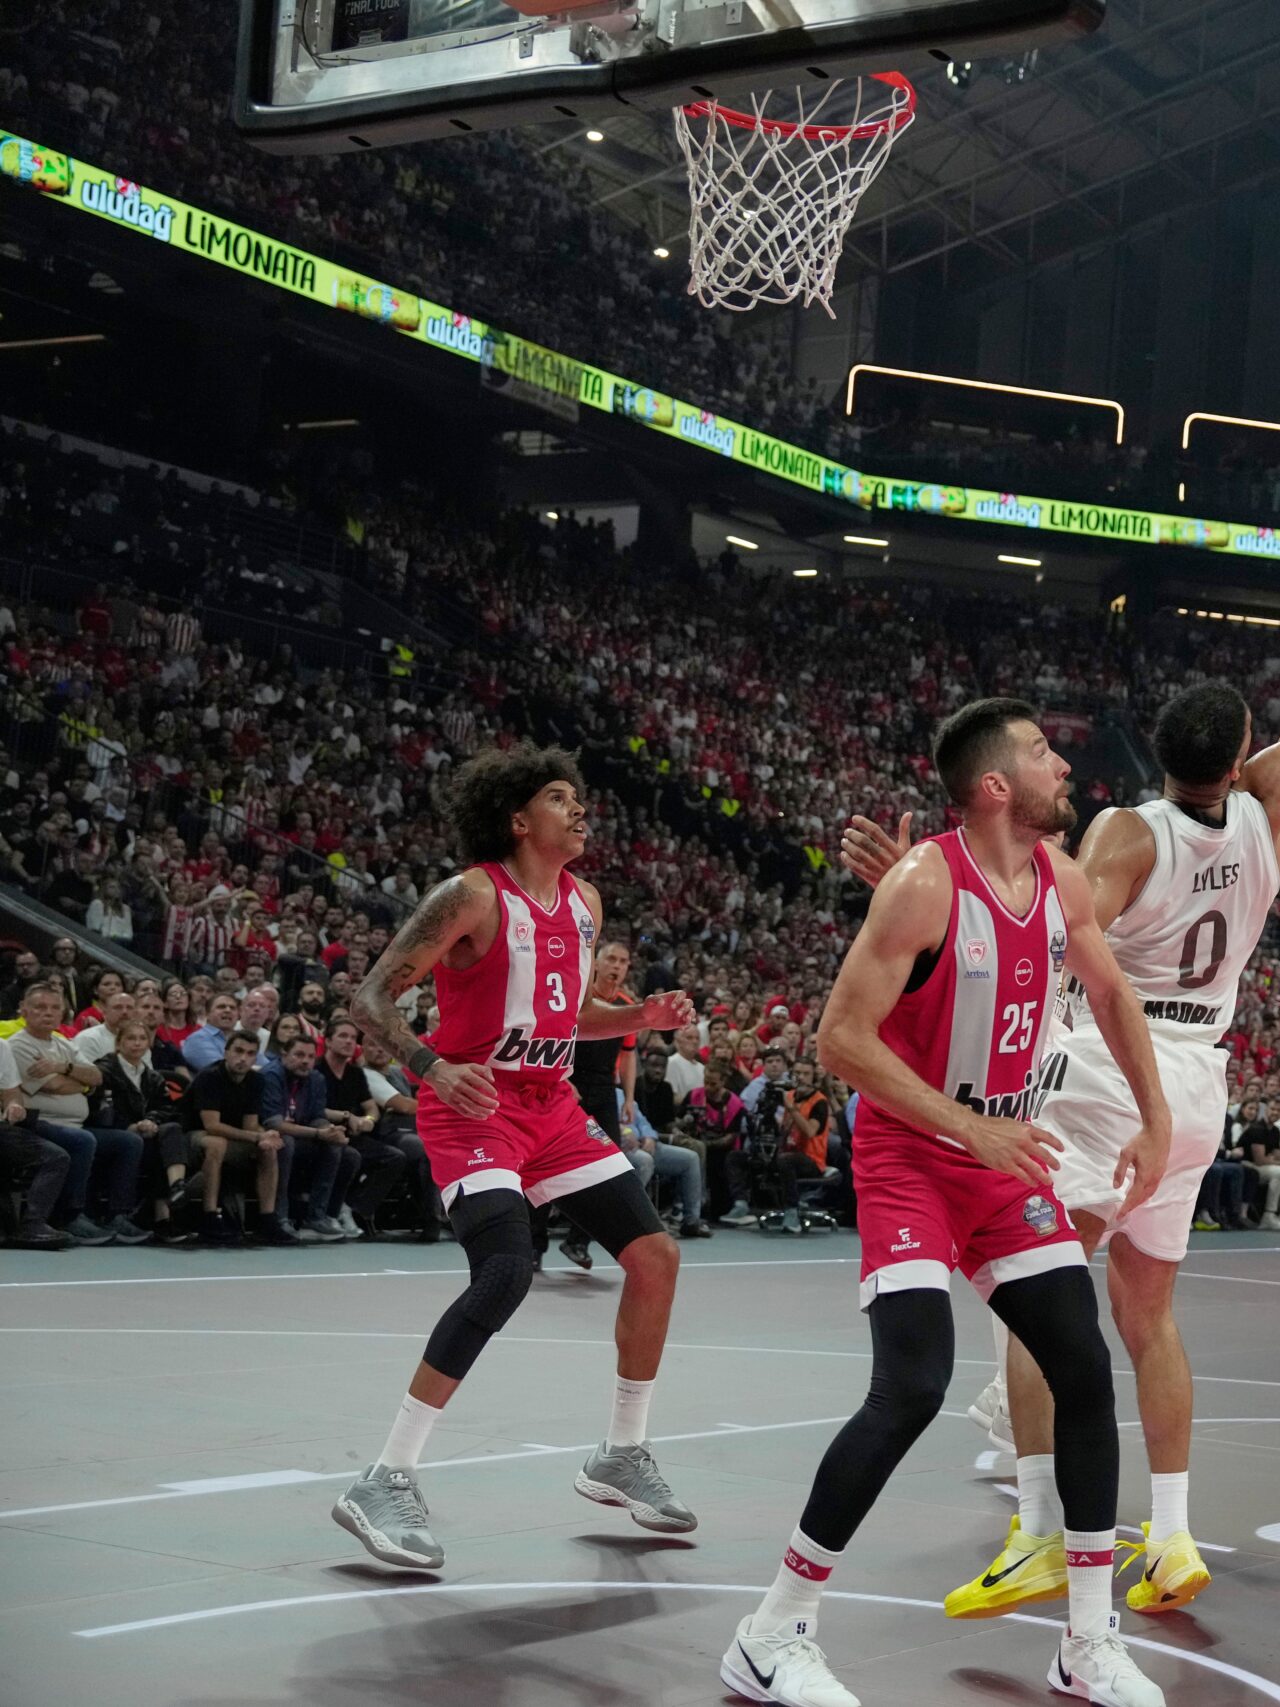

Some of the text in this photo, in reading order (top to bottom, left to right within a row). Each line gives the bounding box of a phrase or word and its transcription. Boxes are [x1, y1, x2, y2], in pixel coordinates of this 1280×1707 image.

[81, 180, 175, 243] uludağ
[1192, 863, 1240, 893] LYLES
[1177, 909, 1228, 989] 0
[546, 972, 568, 1013] 3
[997, 1000, 1037, 1055] 25
[891, 1240, 921, 1253] FlexCar
